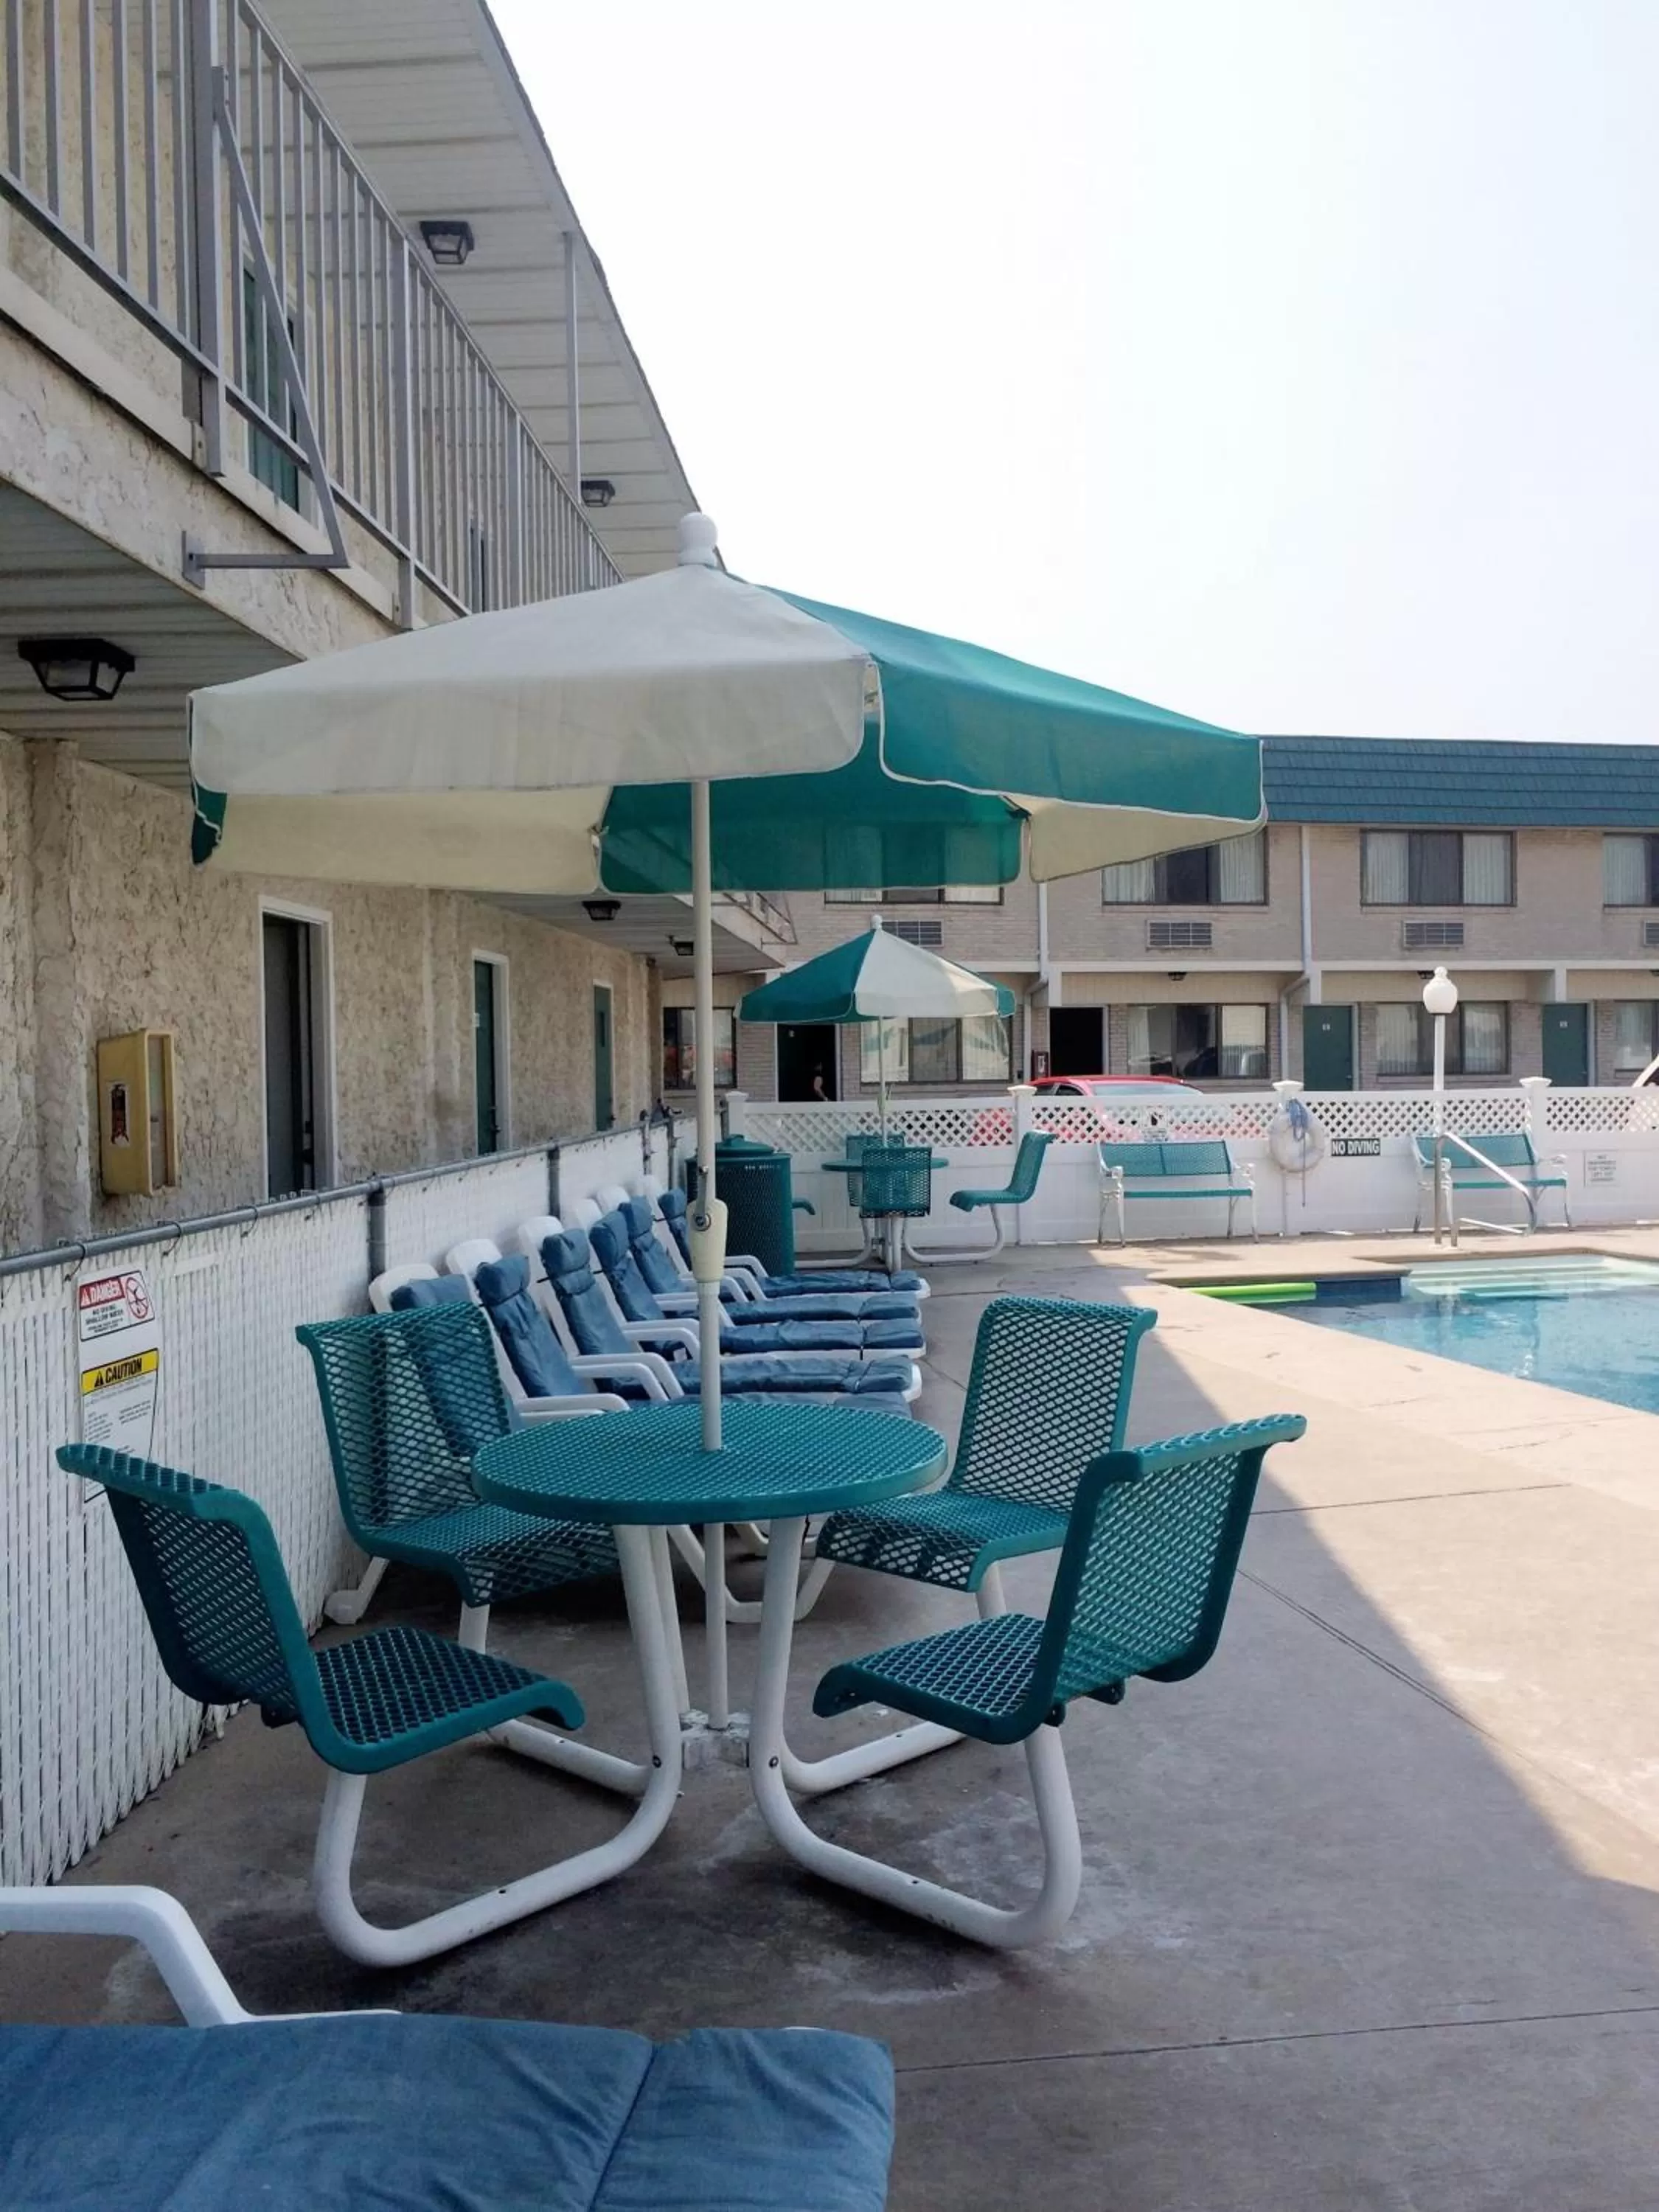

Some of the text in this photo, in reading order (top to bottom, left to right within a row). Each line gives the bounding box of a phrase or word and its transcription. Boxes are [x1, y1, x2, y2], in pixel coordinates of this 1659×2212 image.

[1332, 1140, 1380, 1155] NO DIVING
[90, 1279, 119, 1304] DANGER
[105, 1358, 142, 1382] CAUTION
